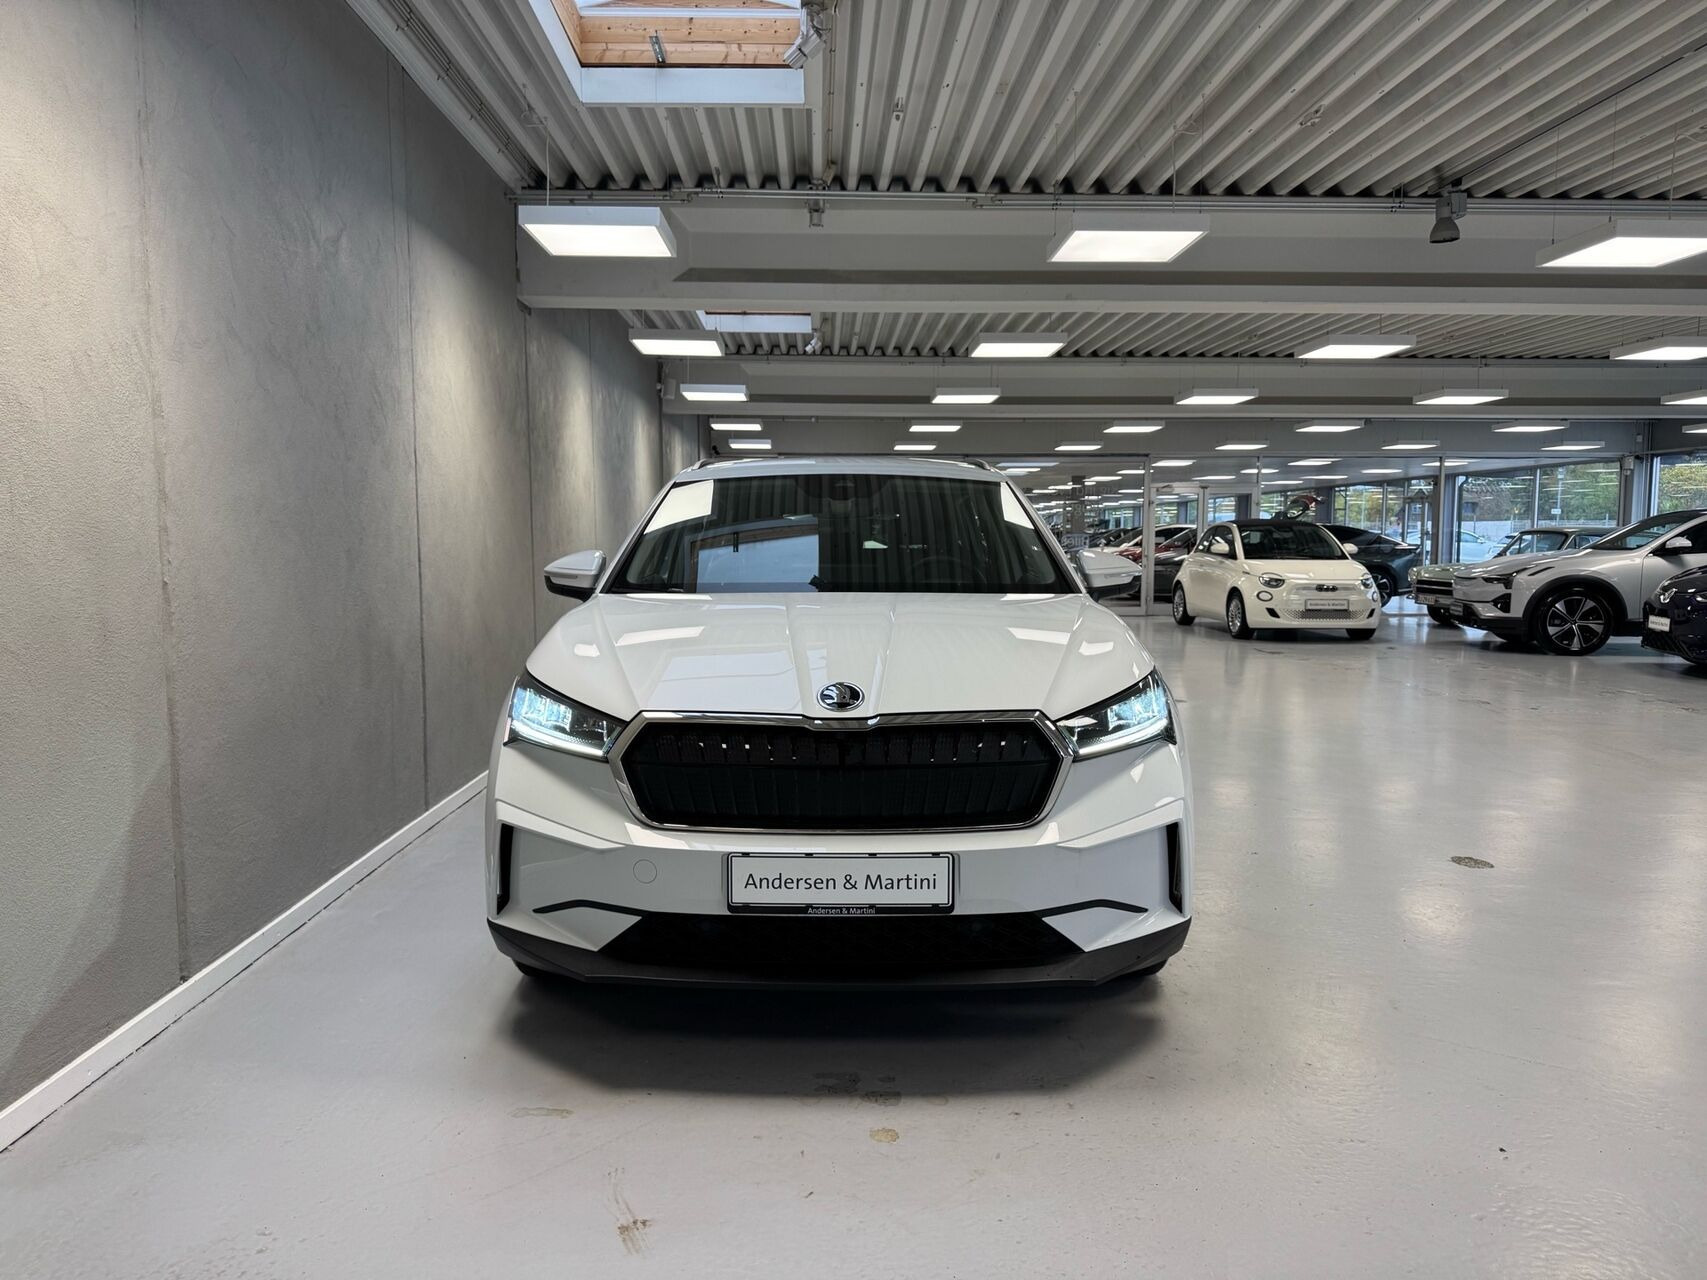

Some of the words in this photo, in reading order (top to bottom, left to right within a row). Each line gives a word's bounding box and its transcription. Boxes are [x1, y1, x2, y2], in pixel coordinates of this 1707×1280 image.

[743, 872, 838, 890] Andersen
[842, 873, 858, 890] &
[864, 872, 937, 890] Martini
[807, 906, 840, 915] Andersen
[849, 906, 876, 914] Martini
